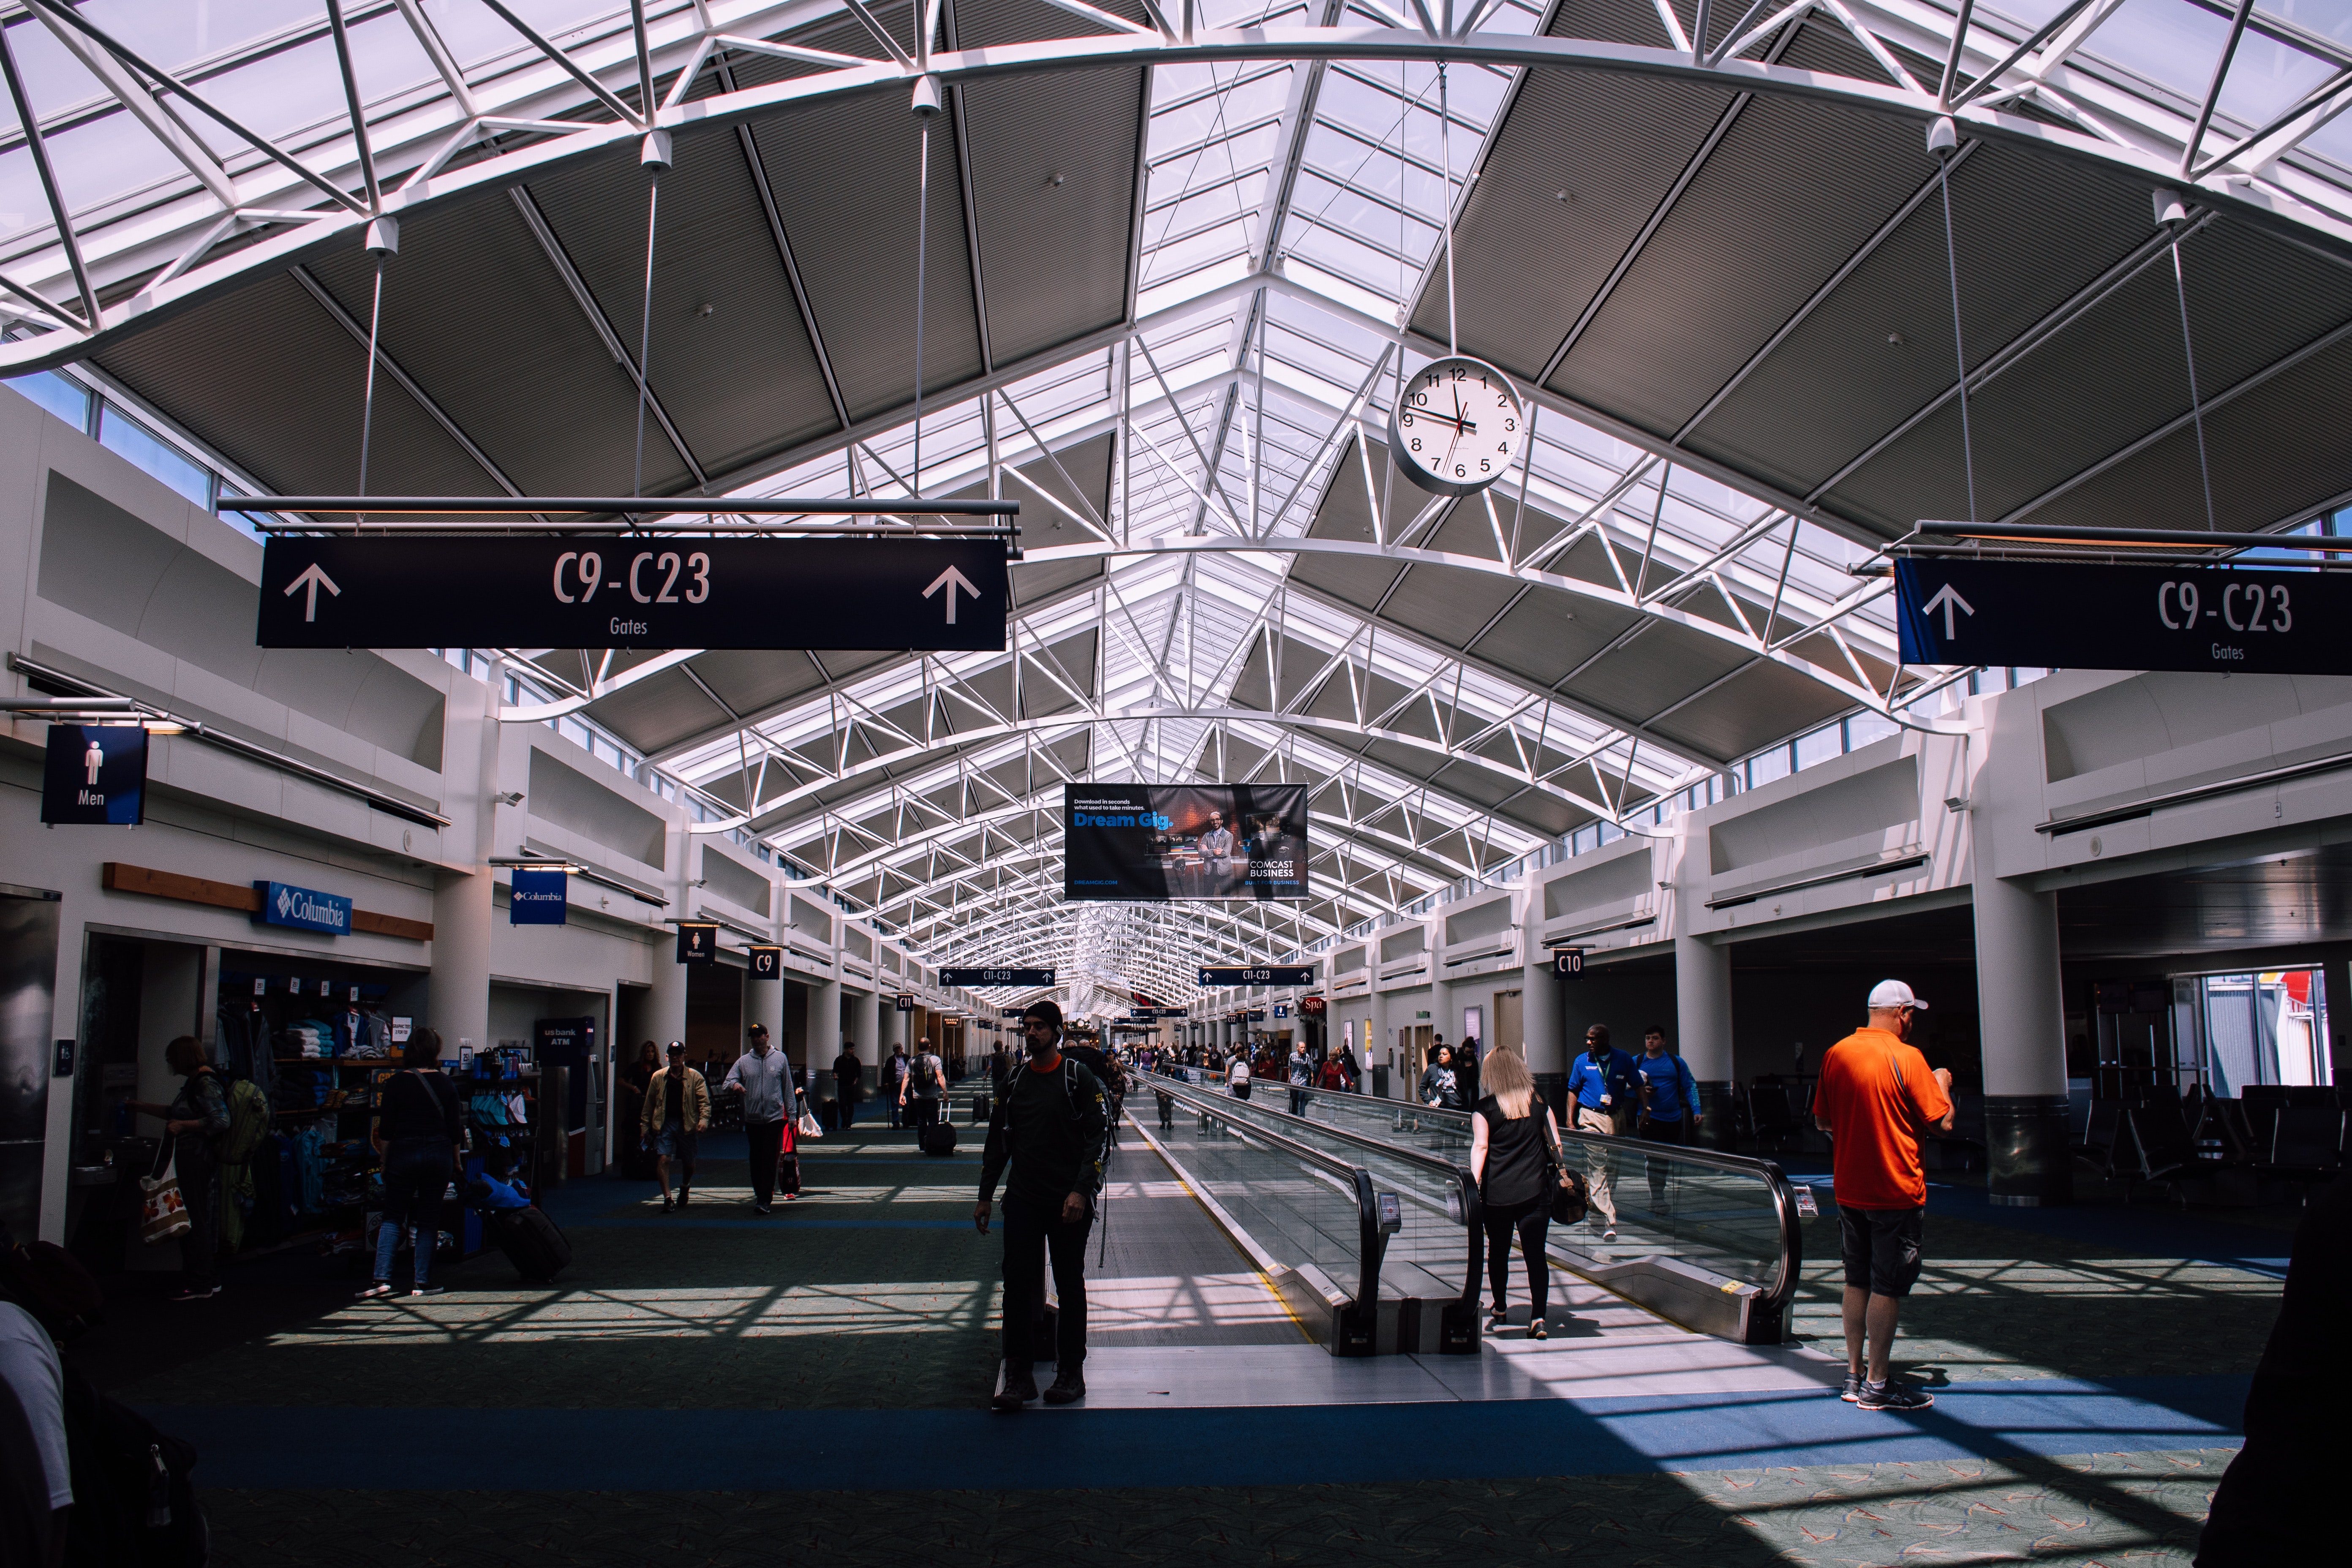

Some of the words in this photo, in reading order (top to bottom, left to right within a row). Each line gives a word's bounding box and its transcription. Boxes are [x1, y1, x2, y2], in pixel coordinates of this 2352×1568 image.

[1425, 374, 1440, 387] 11
[1448, 368, 1467, 381] 12
[1480, 376, 1487, 389] 1
[1409, 392, 1428, 406] 10
[1497, 395, 1507, 407] 2
[1403, 414, 1413, 427] 9
[1505, 419, 1515, 431] 3
[1411, 438, 1422, 451] 8
[1497, 442, 1508, 455] 4
[1431, 458, 1441, 471] 7
[1455, 464, 1466, 477] 6
[1480, 459, 1490, 472] 5
[553, 552, 710, 604] C9-C23
[2158, 581, 2292, 633] C9-C23
[610, 617, 647, 634] Gates
[2212, 643, 2245, 660] Gates
[78, 789, 104, 805] Men
[1074, 813, 1135, 827] Dream
[1138, 811, 1173, 831] Gig.
[1250, 860, 1293, 868] COMCAST
[523, 892, 562, 900] Columbia
[291, 892, 344, 927] Columbia
[757, 955, 772, 971] C9
[1559, 956, 1581, 972] C10
[984, 971, 1010, 980] C11-C23
[1243, 970, 1270, 979] C11-C23
[900, 998, 910, 1007] C11
[1306, 999, 1322, 1012] Spa
